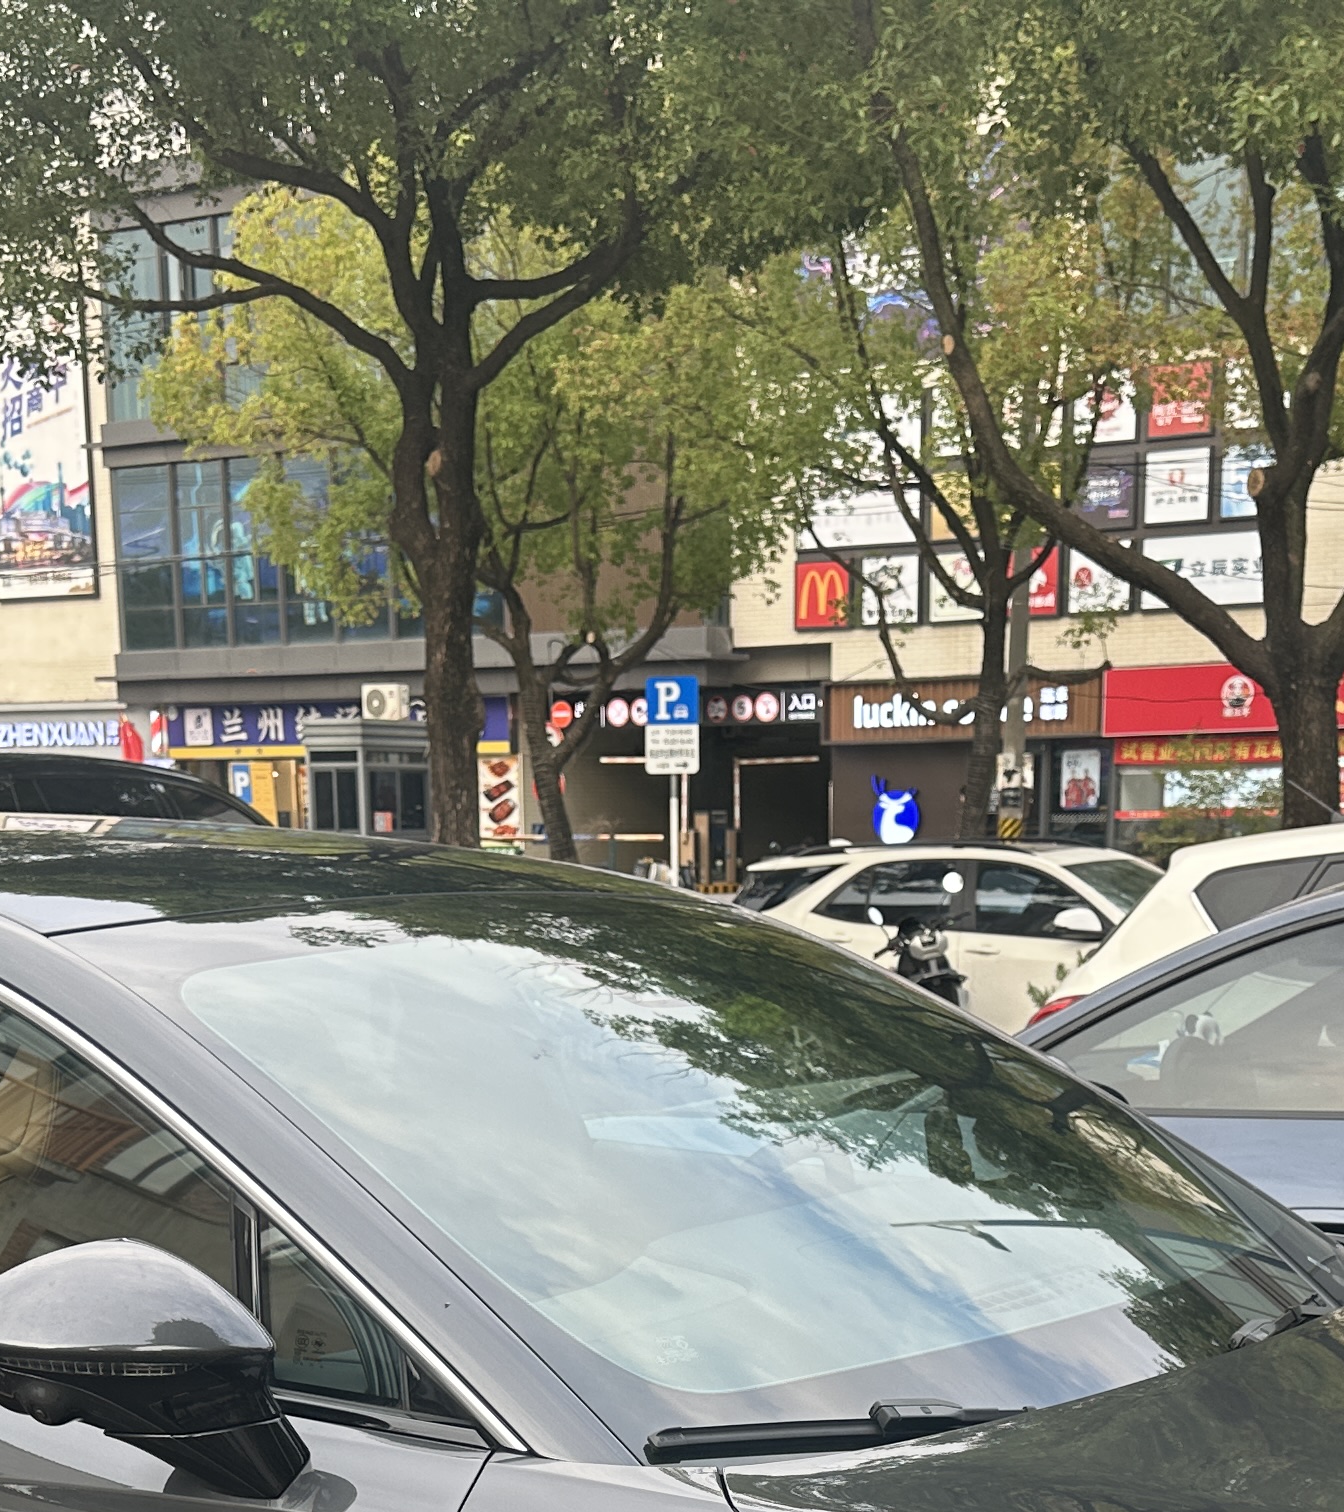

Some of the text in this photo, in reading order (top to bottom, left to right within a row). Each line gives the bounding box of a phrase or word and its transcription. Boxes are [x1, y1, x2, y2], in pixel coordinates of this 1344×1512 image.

[654, 681, 682, 721] P
[787, 692, 816, 711] 入口
[233, 770, 251, 797] P
